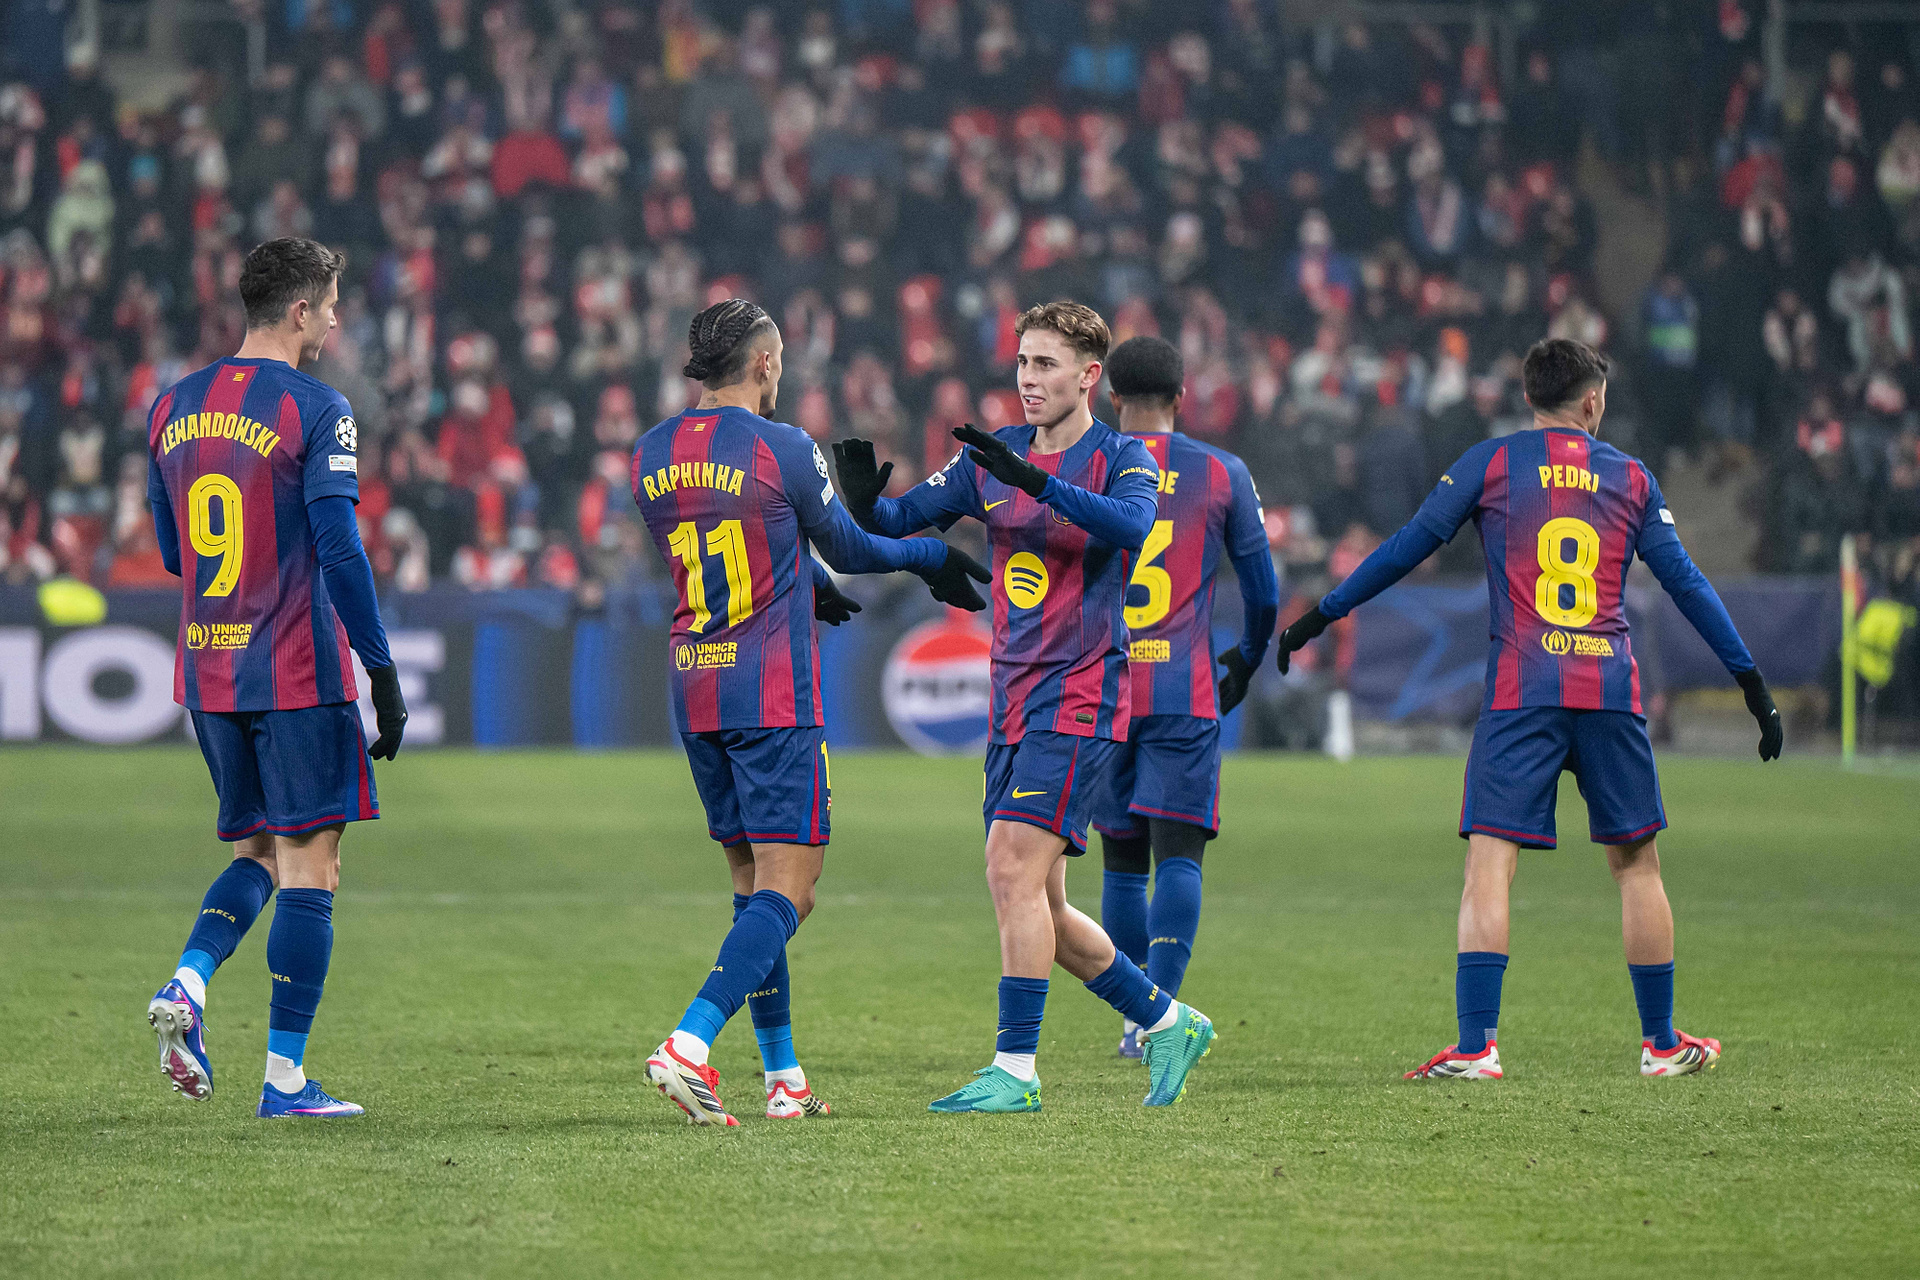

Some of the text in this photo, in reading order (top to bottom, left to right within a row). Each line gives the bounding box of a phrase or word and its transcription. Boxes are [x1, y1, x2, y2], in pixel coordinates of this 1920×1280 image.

[162, 412, 281, 458] LEWANDOWSKI
[643, 462, 745, 501] RAPHINHA
[1538, 465, 1599, 493] PEDRI
[188, 473, 243, 597] 9
[667, 520, 753, 634] 11
[1535, 517, 1600, 628] 8
[211, 624, 252, 634] UNHCR
[211, 634, 250, 646] ACNUR
[696, 642, 738, 653] UNHCR
[697, 653, 737, 664] ACNUR
